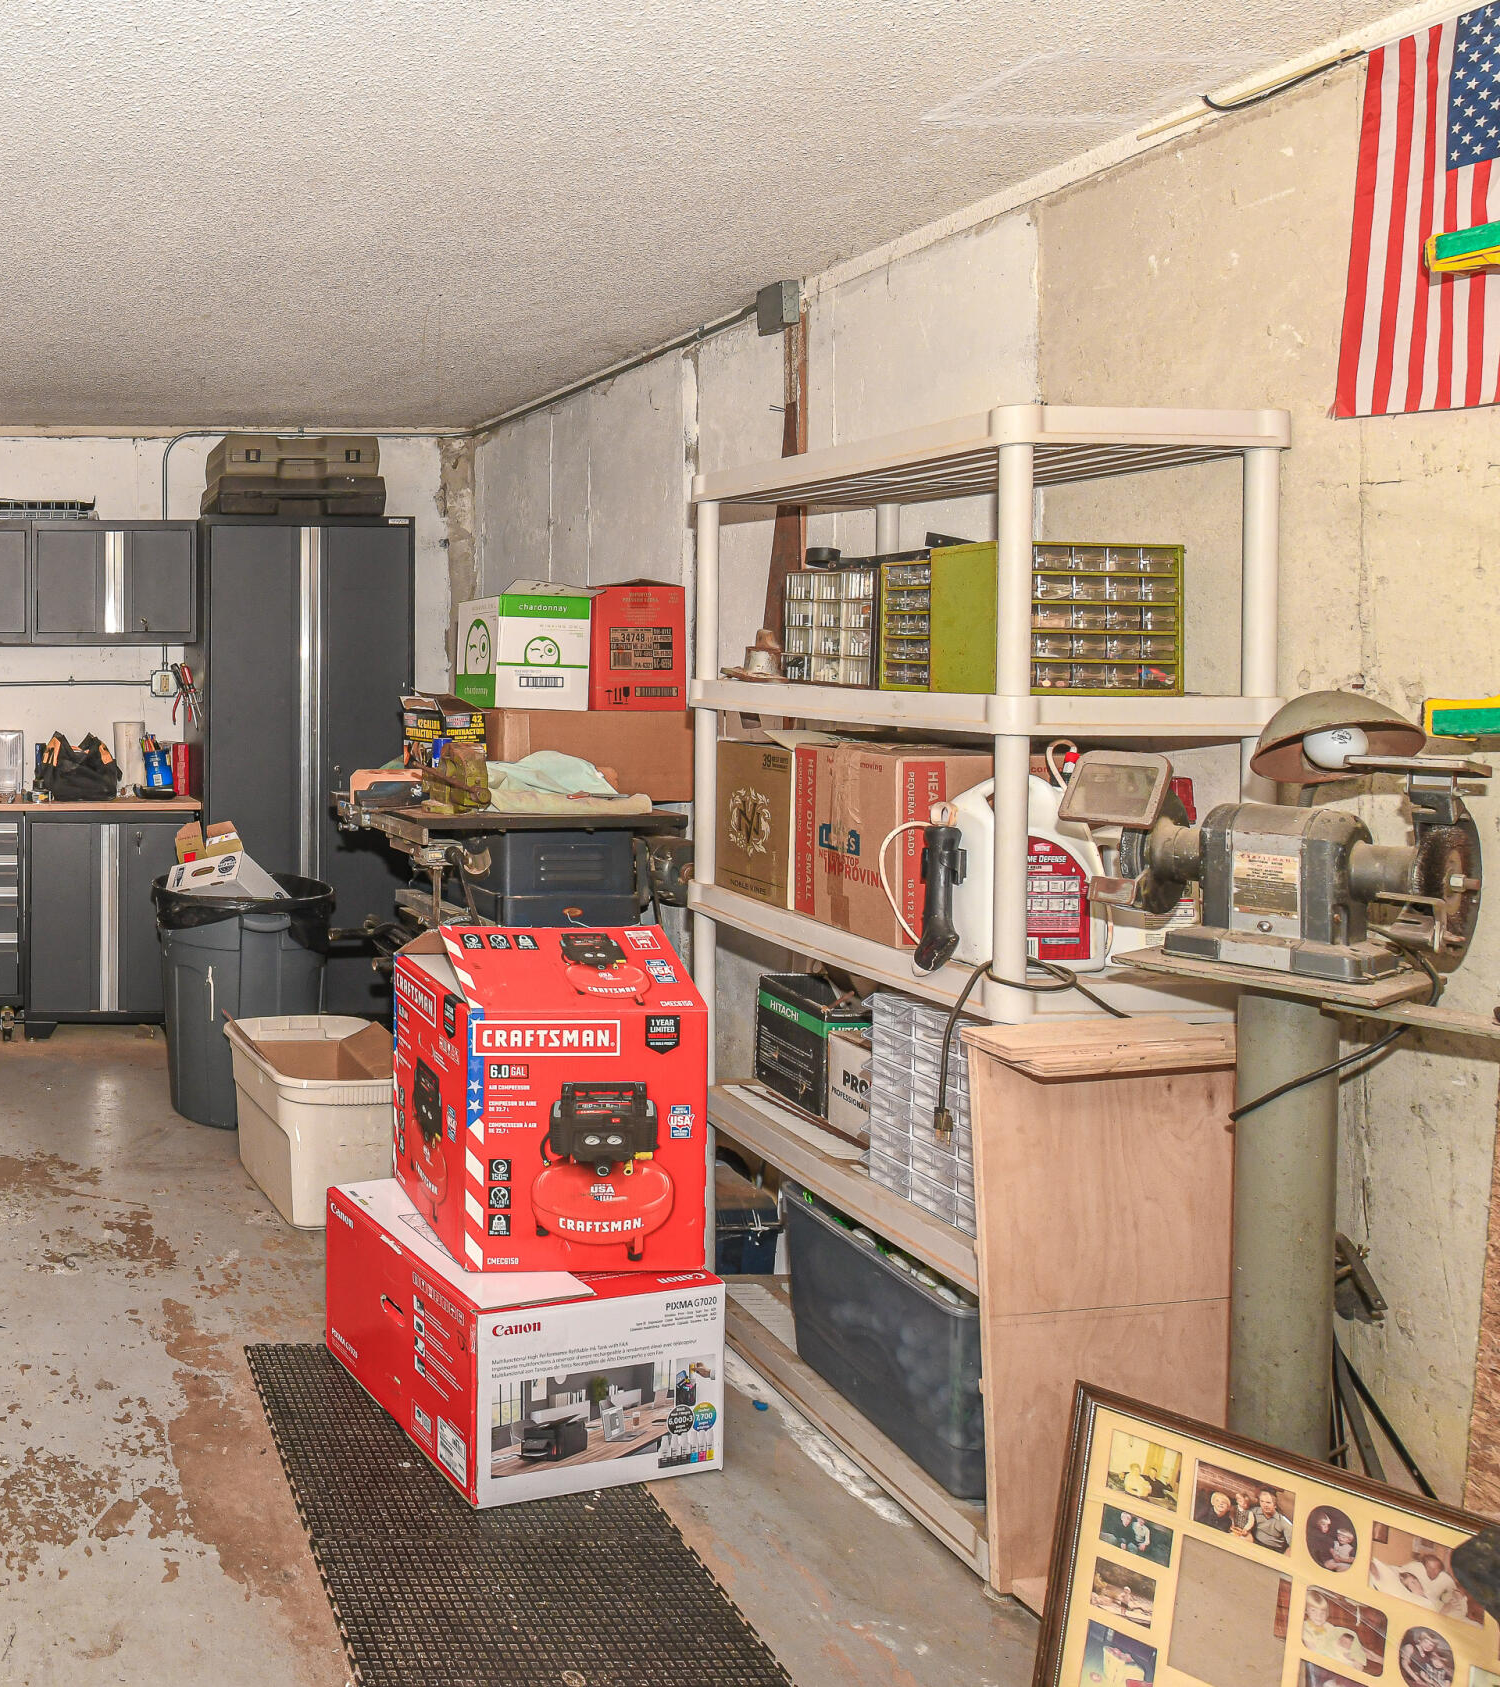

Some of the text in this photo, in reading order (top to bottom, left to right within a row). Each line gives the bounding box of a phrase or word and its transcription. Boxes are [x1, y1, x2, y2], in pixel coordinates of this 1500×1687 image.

[519, 603, 568, 613] chardonnay
[762, 753, 772, 768] 39
[859, 761, 883, 772] moving
[806, 758, 814, 805] HEAVY
[907, 818, 915, 856] PSADO
[841, 855, 859, 866] STOP
[804, 853, 812, 901] SMALL
[824, 859, 884, 889] IMPROVIN
[648, 967, 672, 975] USA
[396, 972, 433, 1017] CRAFTSMAN
[588, 986, 637, 994] CRAFTSMAN
[770, 999, 799, 1022] HITACHI
[482, 1029, 612, 1047] CRAFTSMAN
[490, 1064, 525, 1078] 6.0 GAL
[831, 1086, 868, 1113] PROFESSIONAL
[670, 1115, 691, 1125] USA
[330, 1202, 354, 1229] Canon
[558, 1217, 642, 1233] CRAFTSMAN
[656, 1273, 706, 1284] Canon
[665, 1296, 718, 1311] PIXMA G7020
[491, 1321, 541, 1337] Canon
